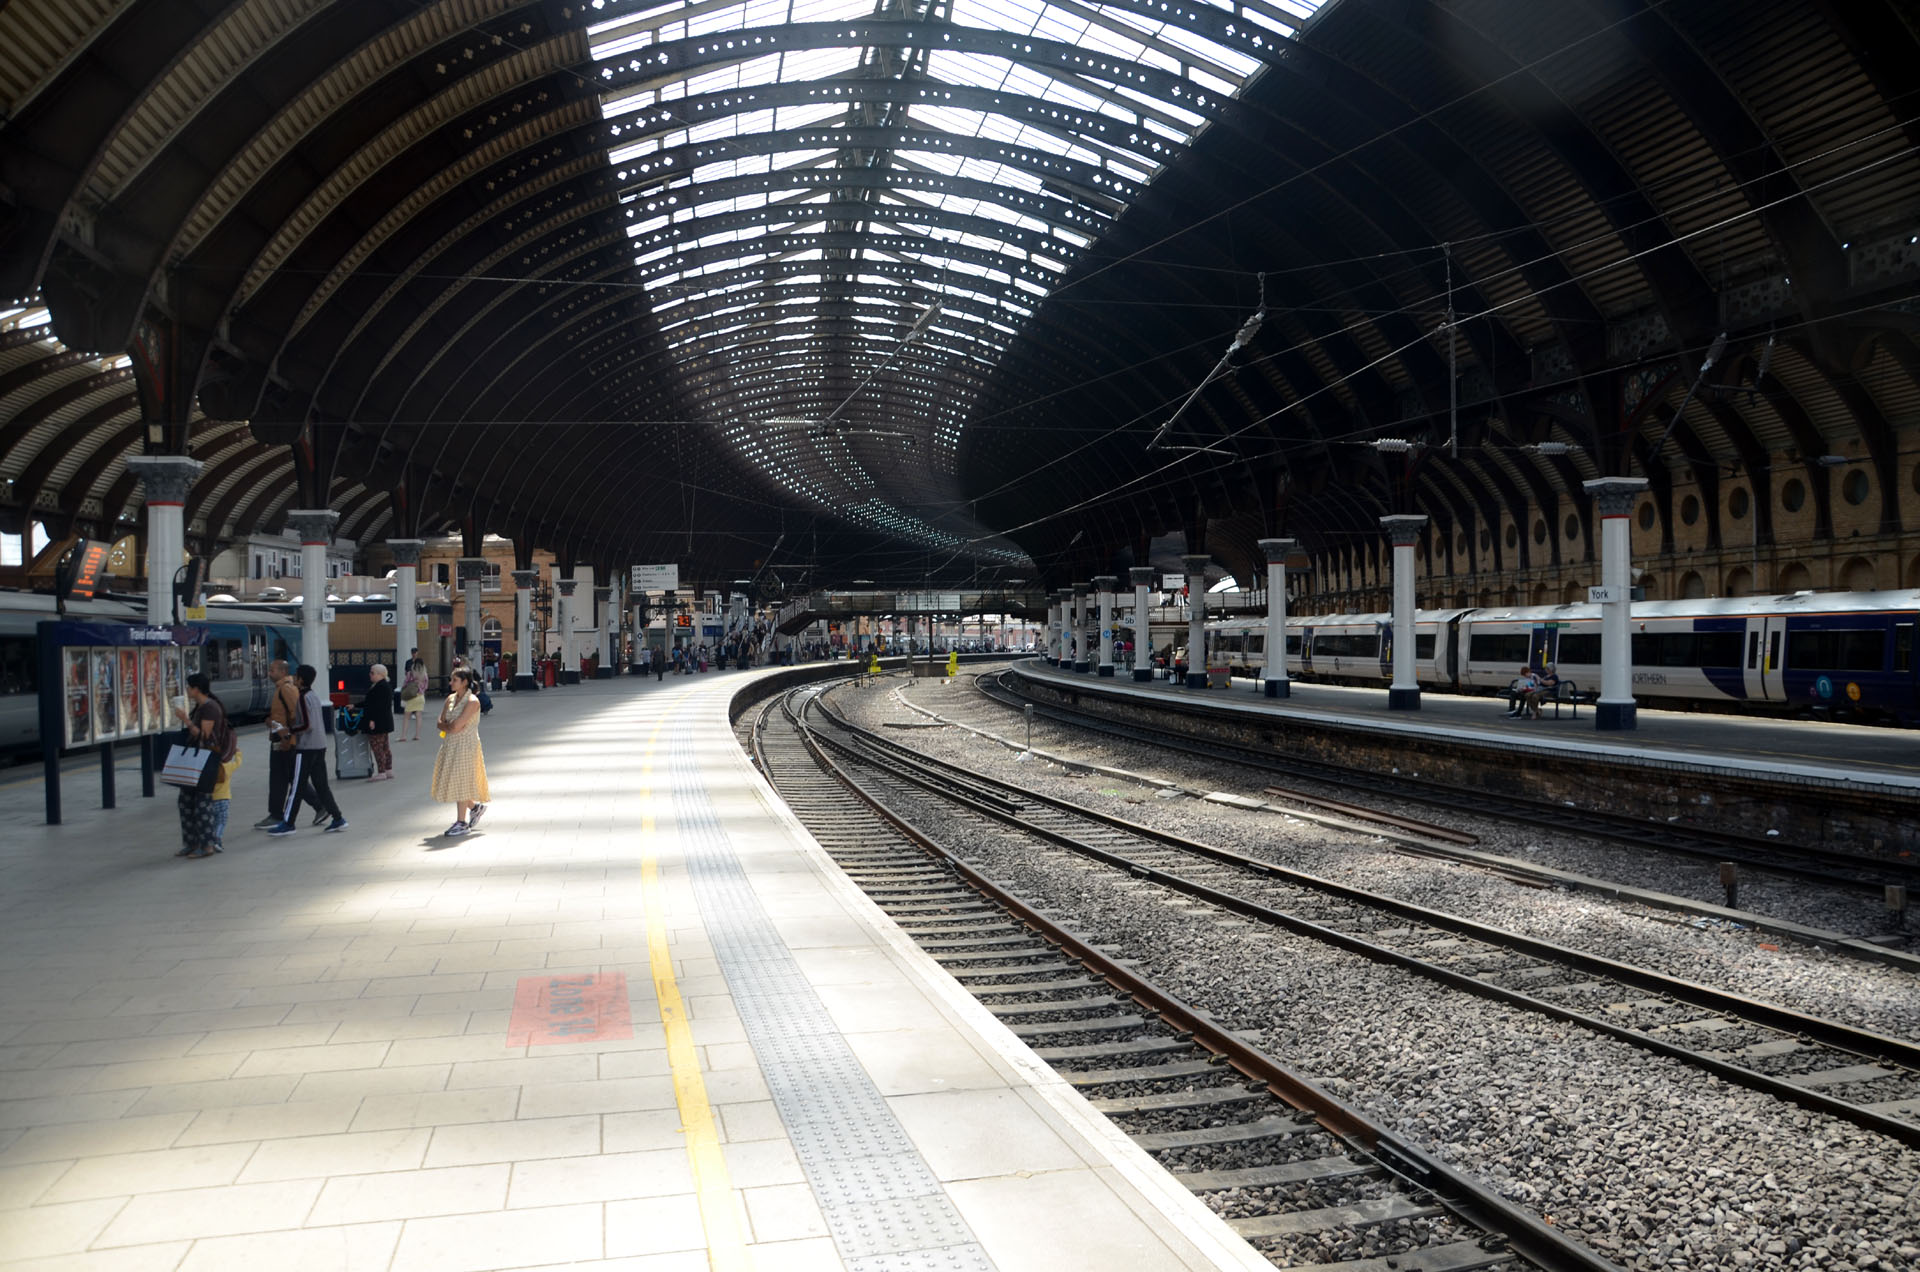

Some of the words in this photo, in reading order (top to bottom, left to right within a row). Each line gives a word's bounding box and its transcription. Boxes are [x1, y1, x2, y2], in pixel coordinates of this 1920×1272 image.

[1591, 589, 1608, 600] York
[385, 612, 393, 624] 2
[1125, 617, 1135, 625] 5b
[129, 628, 145, 641] Travel
